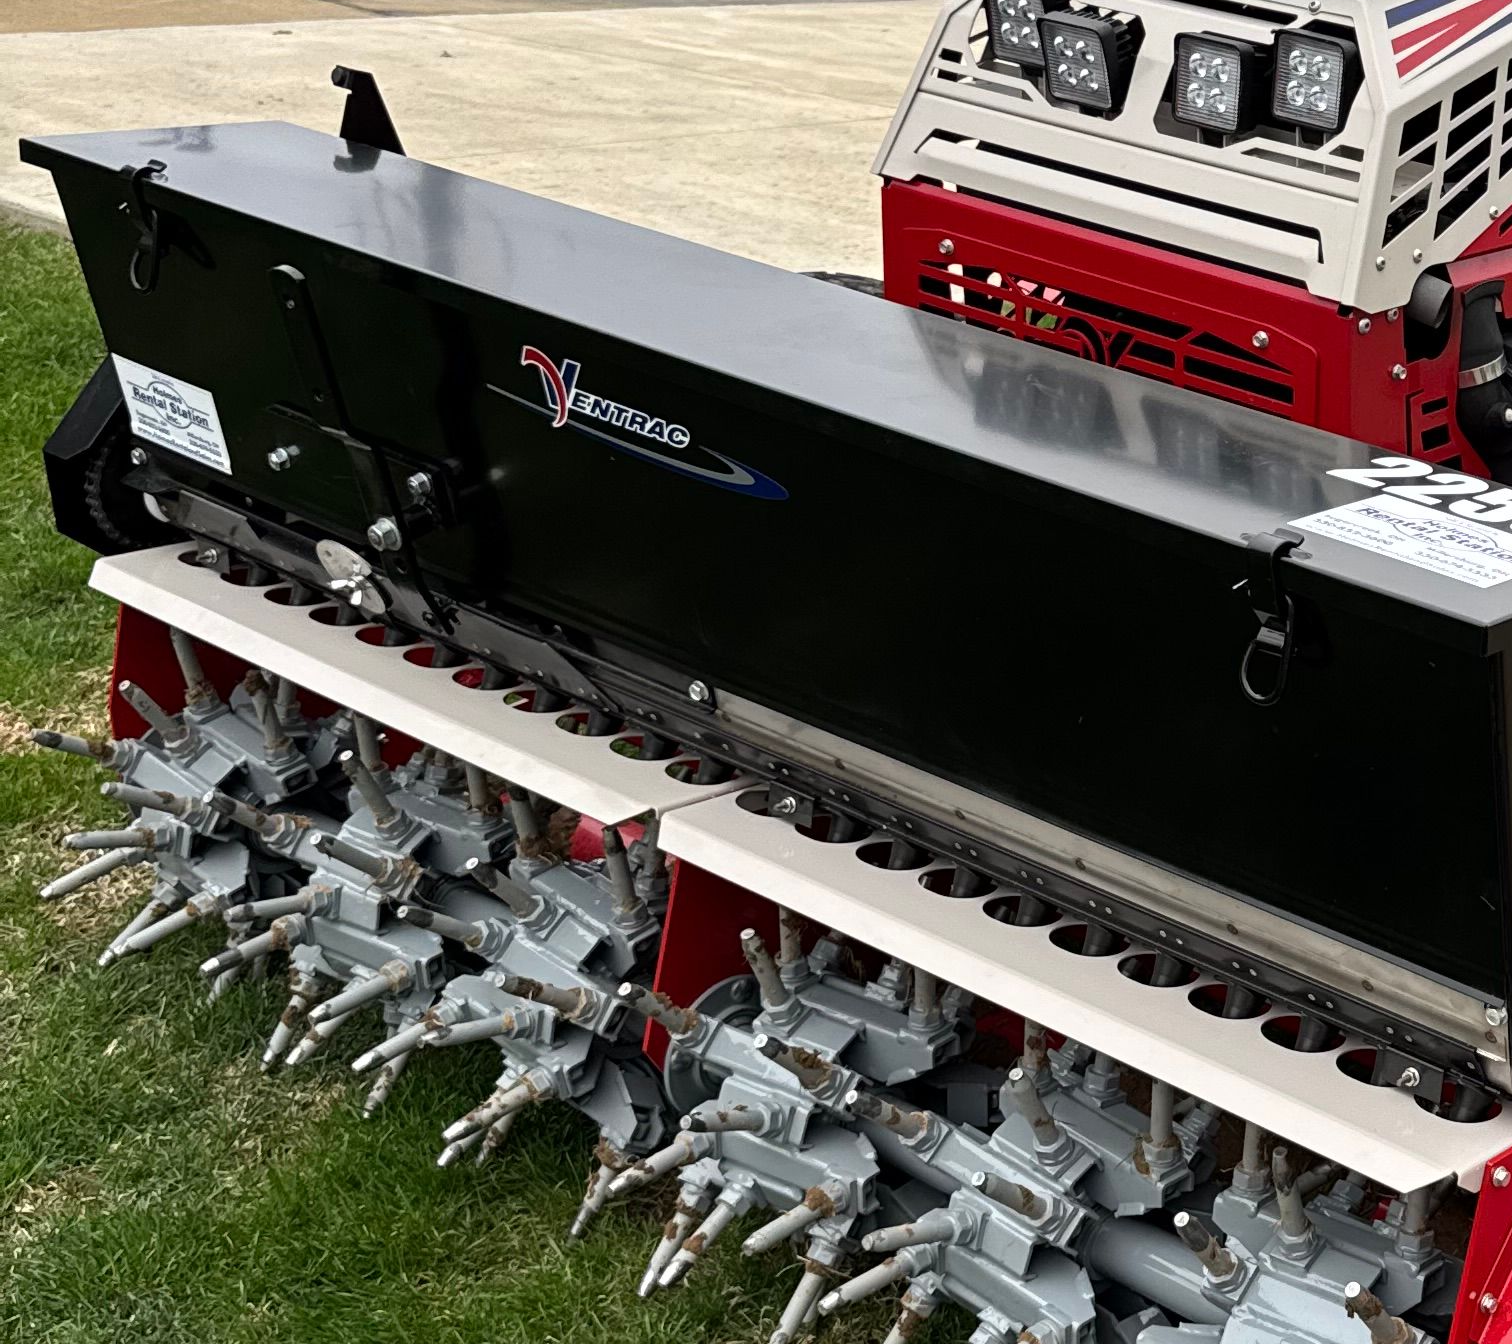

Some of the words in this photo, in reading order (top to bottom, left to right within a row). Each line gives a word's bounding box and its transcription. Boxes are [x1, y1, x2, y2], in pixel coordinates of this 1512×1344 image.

[132, 385, 168, 411] Rental
[168, 401, 209, 427] Station
[152, 385, 182, 405] Holmes
[520, 345, 690, 449] VENTRAC
[1356, 507, 1440, 534] Rental
[1423, 520, 1489, 544] Holmes
